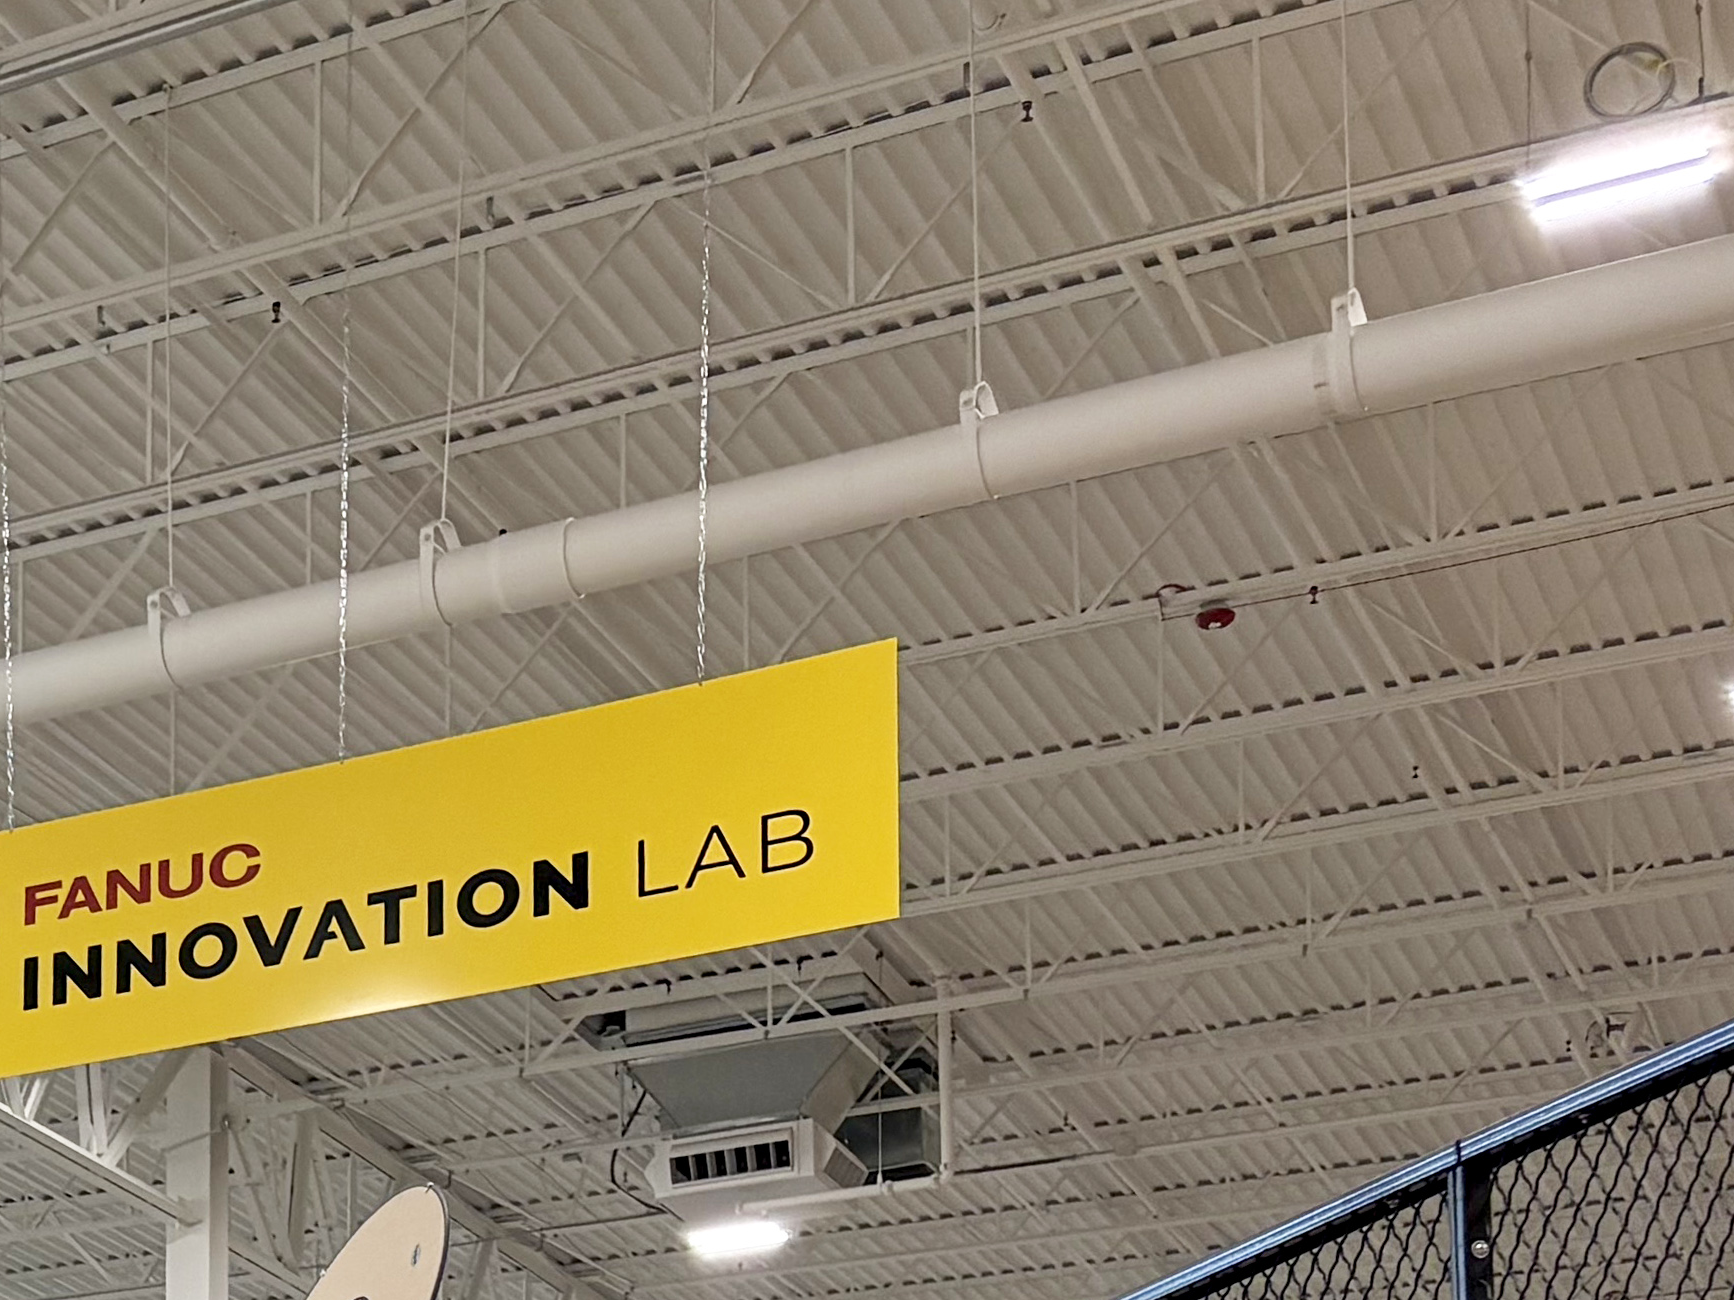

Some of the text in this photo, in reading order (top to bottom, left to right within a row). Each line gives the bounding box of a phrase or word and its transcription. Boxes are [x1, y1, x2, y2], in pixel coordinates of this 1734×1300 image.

[21, 809, 814, 1011] INNOVATION LAB
[22, 842, 261, 926] FANUC
